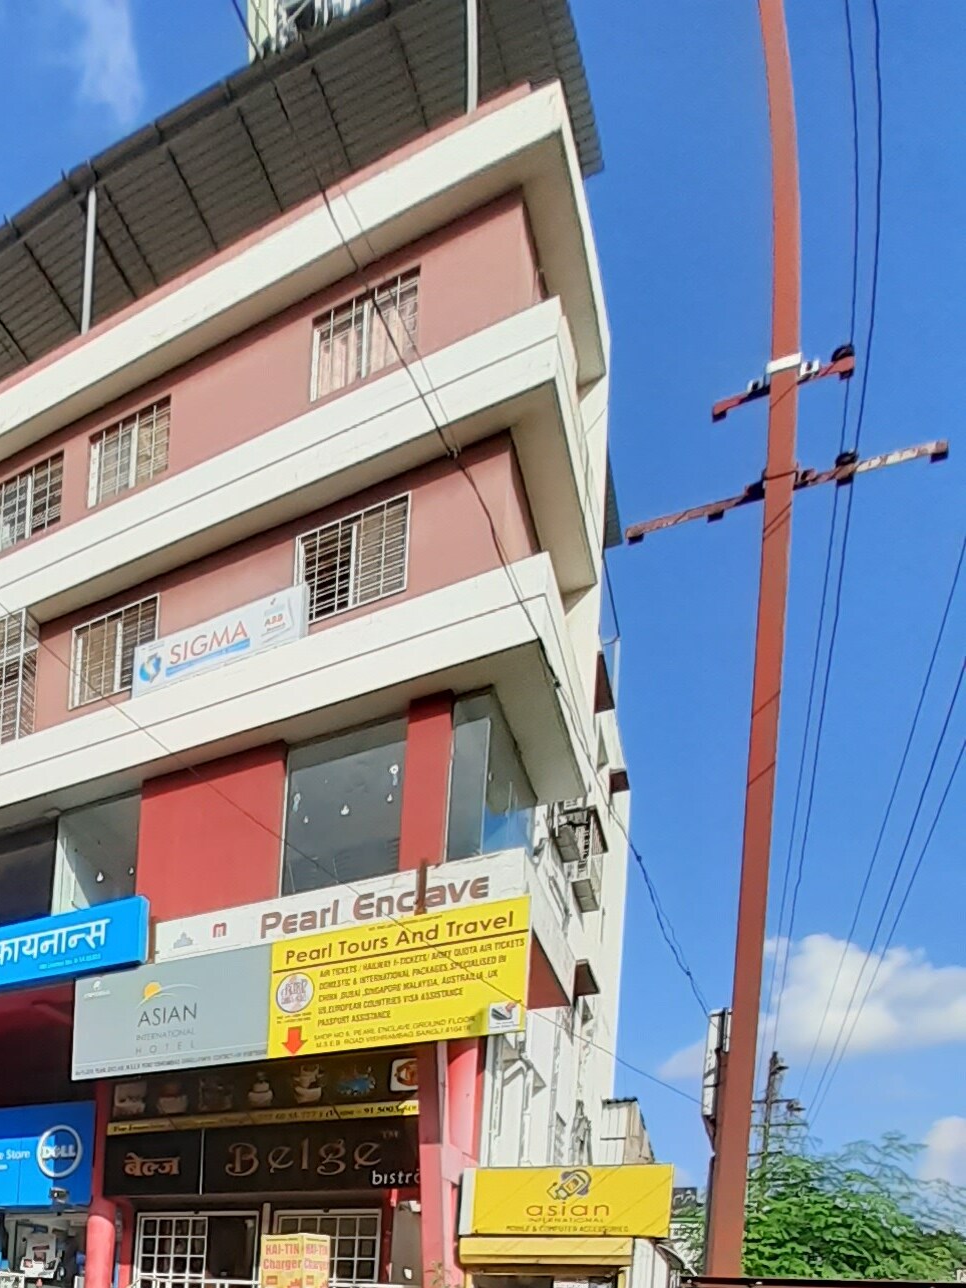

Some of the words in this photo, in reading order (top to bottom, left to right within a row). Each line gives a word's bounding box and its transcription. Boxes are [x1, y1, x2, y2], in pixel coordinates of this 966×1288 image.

[169, 620, 248, 665] SIGMA
[260, 900, 339, 939] Pearl
[353, 876, 490, 921] Encave
[286, 943, 332, 965] Pearl
[338, 937, 389, 955] Tours
[395, 924, 439, 946] And
[446, 911, 514, 938] Travel
[137, 1002, 198, 1027] ASIAN
[136, 1027, 197, 1041] INTERNATIONAL
[5, 1148, 31, 1160] Store
[41, 1145, 76, 1159] DELL
[225, 1137, 382, 1177] Belge
[526, 1202, 610, 1217] asian
[263, 1258, 302, 1270] Charger
